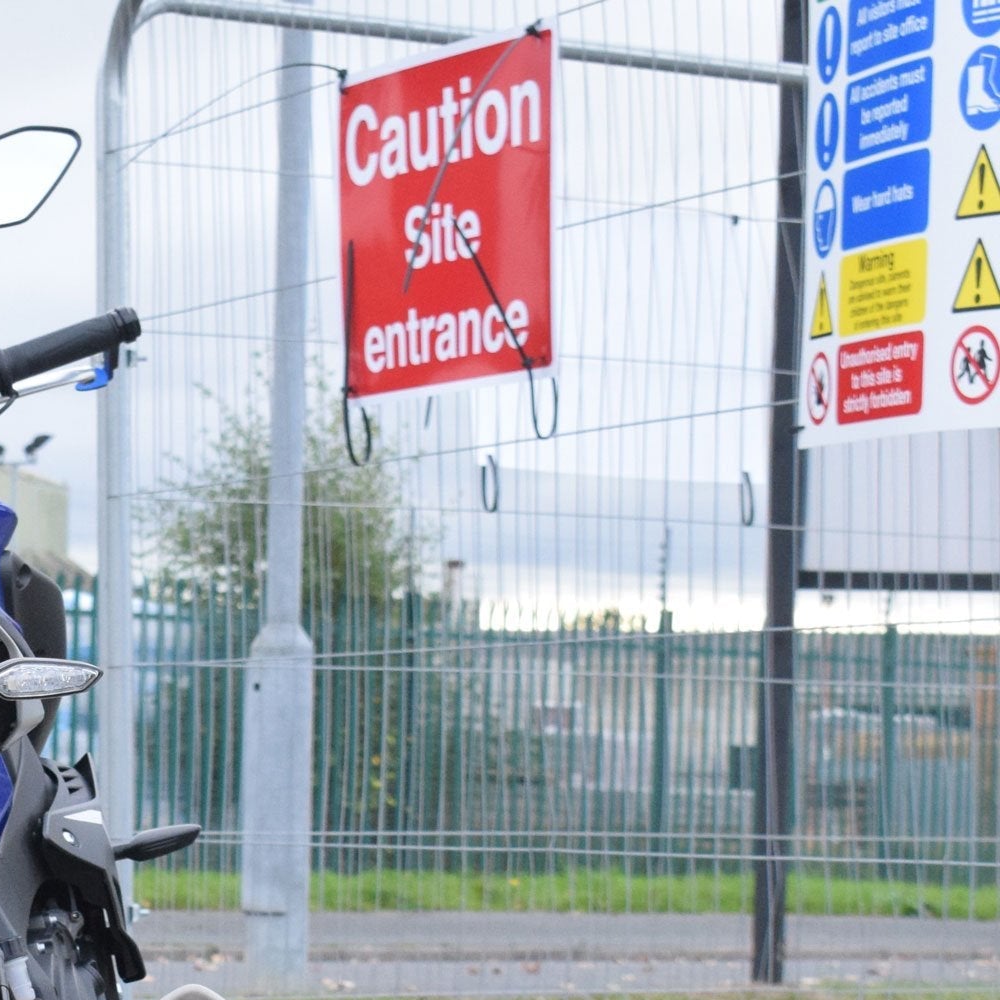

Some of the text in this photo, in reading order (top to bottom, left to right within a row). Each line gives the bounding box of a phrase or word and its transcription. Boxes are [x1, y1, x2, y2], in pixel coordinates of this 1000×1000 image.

[850, 14, 928, 57] report to site office
[849, 64, 926, 105] All accidents must
[861, 93, 909, 125] be reported
[345, 76, 541, 187] Caution
[858, 119, 910, 151] immediately
[871, 187, 892, 208] hard
[891, 183, 914, 203] hats
[404, 202, 481, 269] Site
[858, 252, 895, 272] Warning
[363, 298, 529, 374] entrance
[840, 341, 918, 369] Unauthorised entry
[851, 364, 904, 390] to this site is
[843, 387, 912, 414] strictly forbidden
